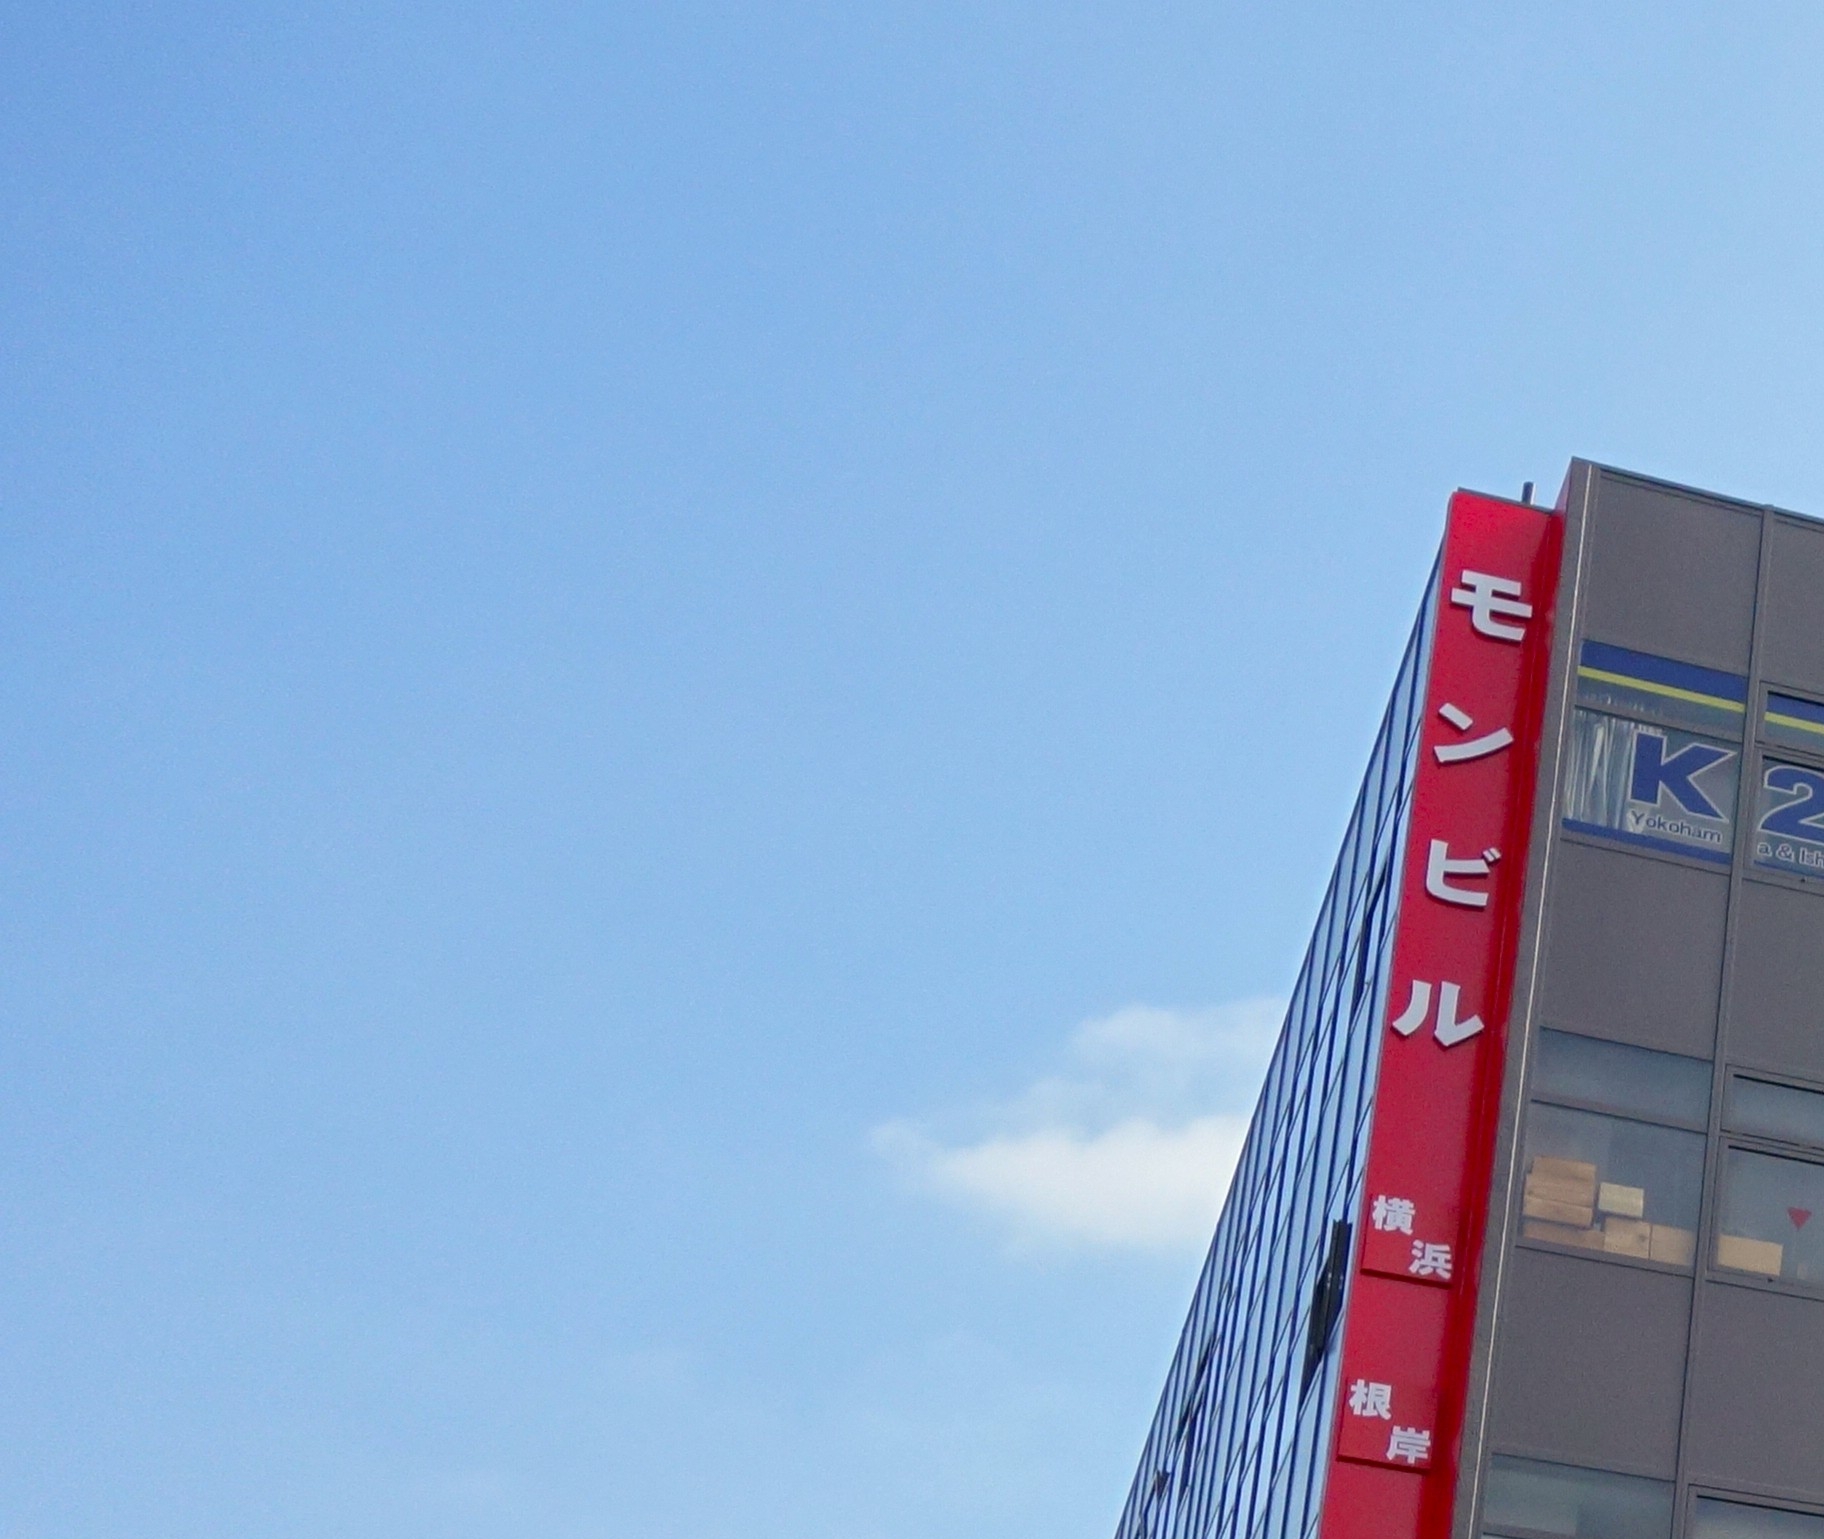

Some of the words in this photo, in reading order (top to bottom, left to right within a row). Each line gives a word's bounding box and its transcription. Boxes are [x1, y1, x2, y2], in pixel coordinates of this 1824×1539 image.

[1391, 570, 1533, 1048] モンビル
[1631, 809, 1772, 857] Yokohama
[1777, 844, 1796, 863] &
[1371, 1194, 1454, 1280] 横浜
[1348, 1379, 1431, 1465] 根岸
